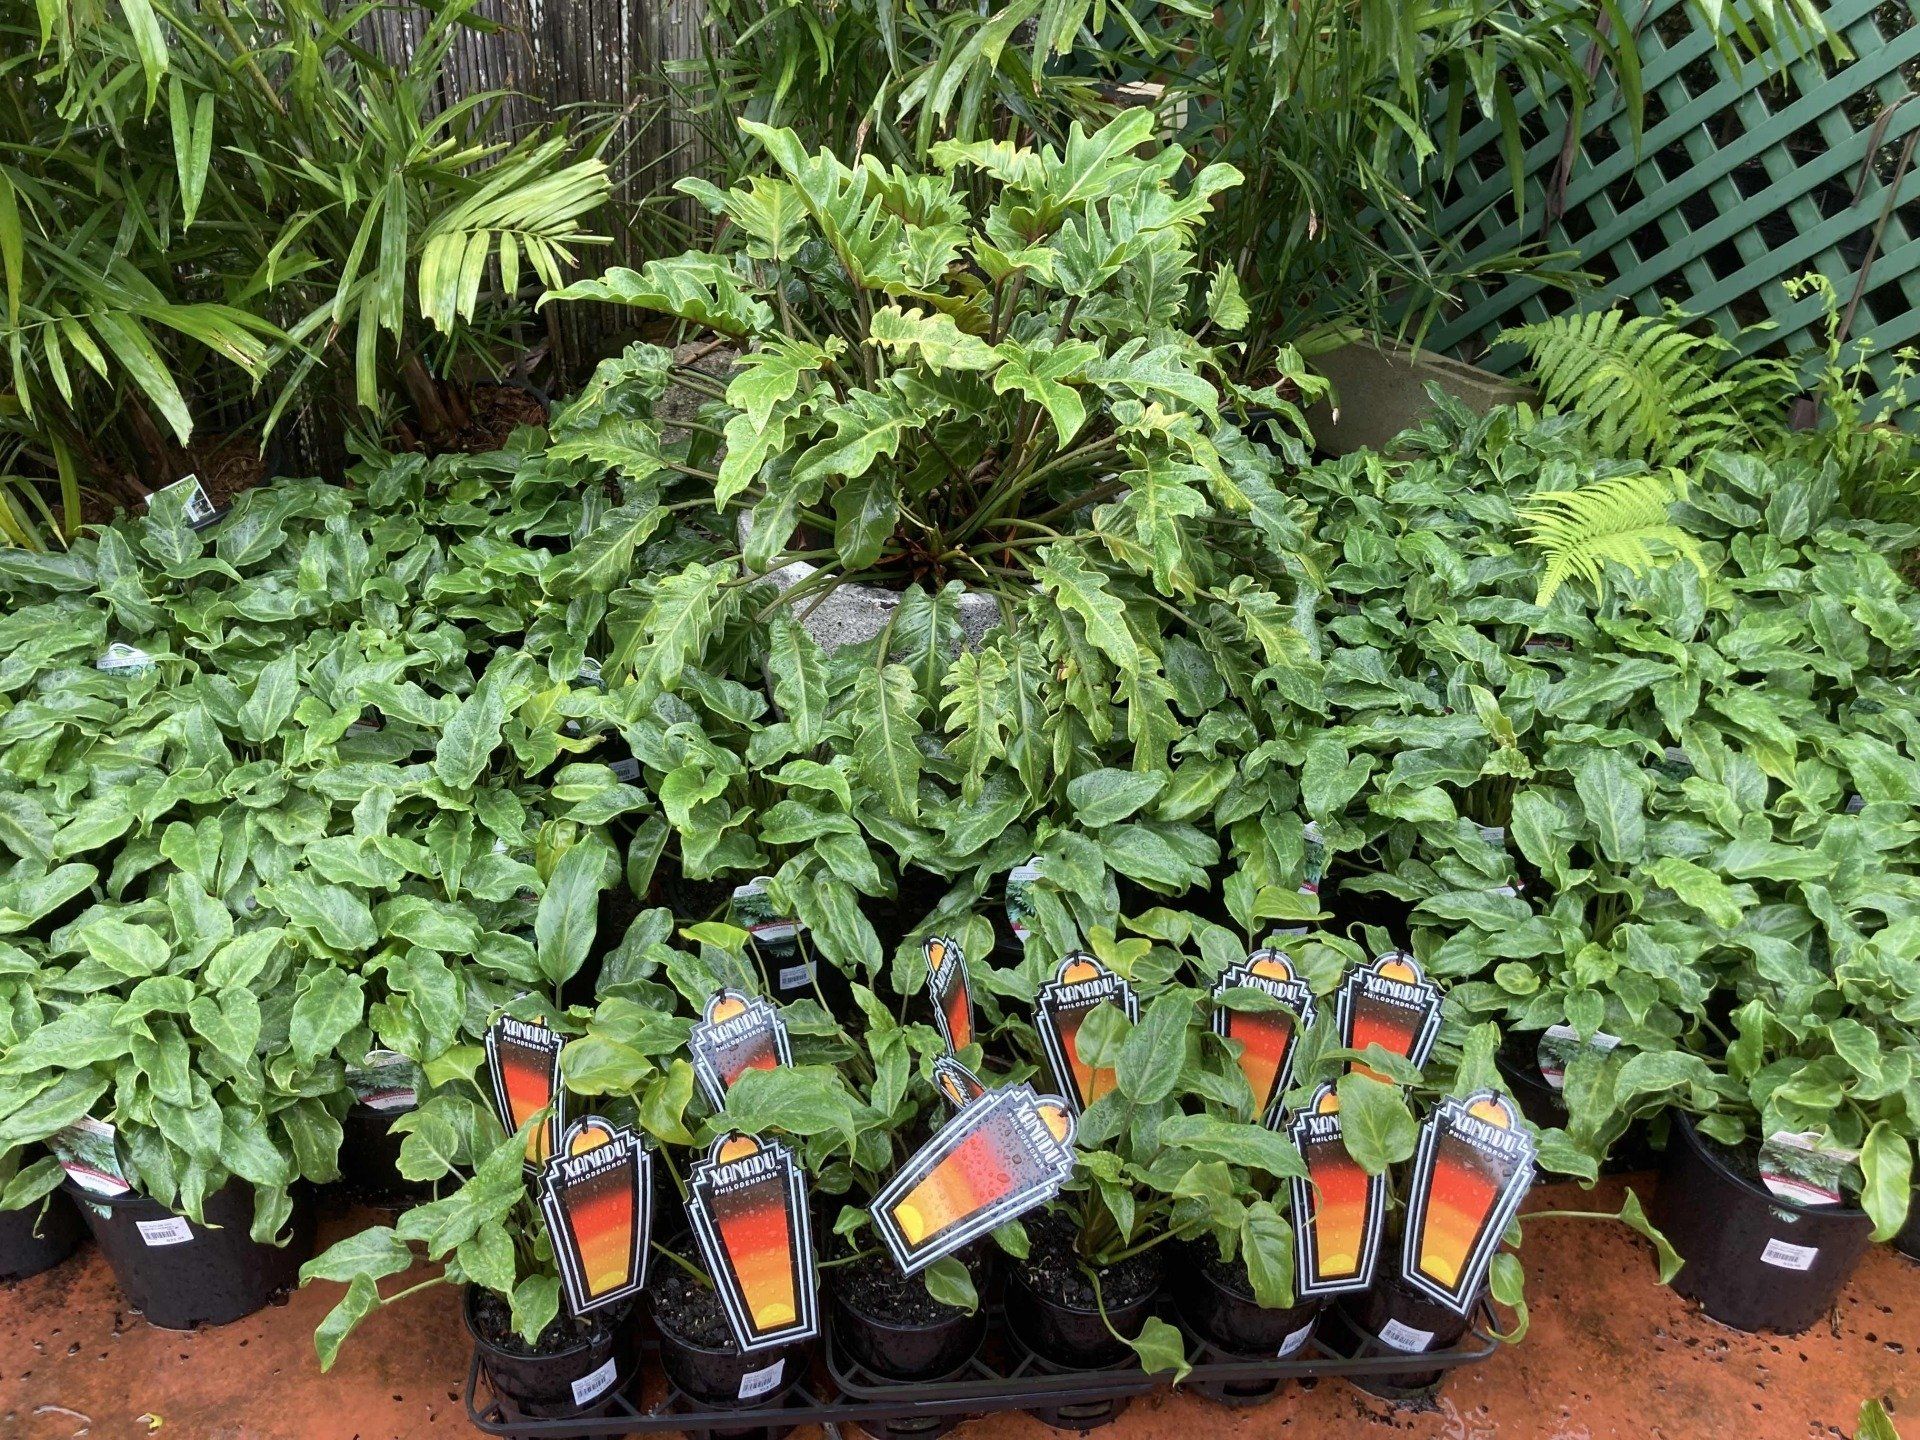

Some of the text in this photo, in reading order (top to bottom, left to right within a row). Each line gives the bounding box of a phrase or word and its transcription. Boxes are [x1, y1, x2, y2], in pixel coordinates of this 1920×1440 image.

[1054, 977, 1113, 1004] XANADU
[1058, 994, 1114, 1011] PHILODENDON
[1363, 991, 1420, 1011] PHILODENDRON
[1364, 975, 1425, 1004] XANADU
[503, 1017, 550, 1045] XANADU
[707, 1008, 762, 1046] XANADU
[715, 1025, 765, 1053] PHILODENDRON
[1013, 1101, 1062, 1164] XANADU
[1309, 1114, 1342, 1136] XAN
[1311, 1133, 1342, 1144] PHILODE
[1450, 1111, 1517, 1153] XANADU
[1006, 1112, 1045, 1169] PHILODENDRON
[1448, 1129, 1509, 1161] PHILODENDRON
[562, 1139, 626, 1181] XANADU
[567, 1158, 627, 1188] PHILODENDRON
[709, 1150, 776, 1188] XANADU
[714, 1171, 778, 1196] PHILODENDRON
